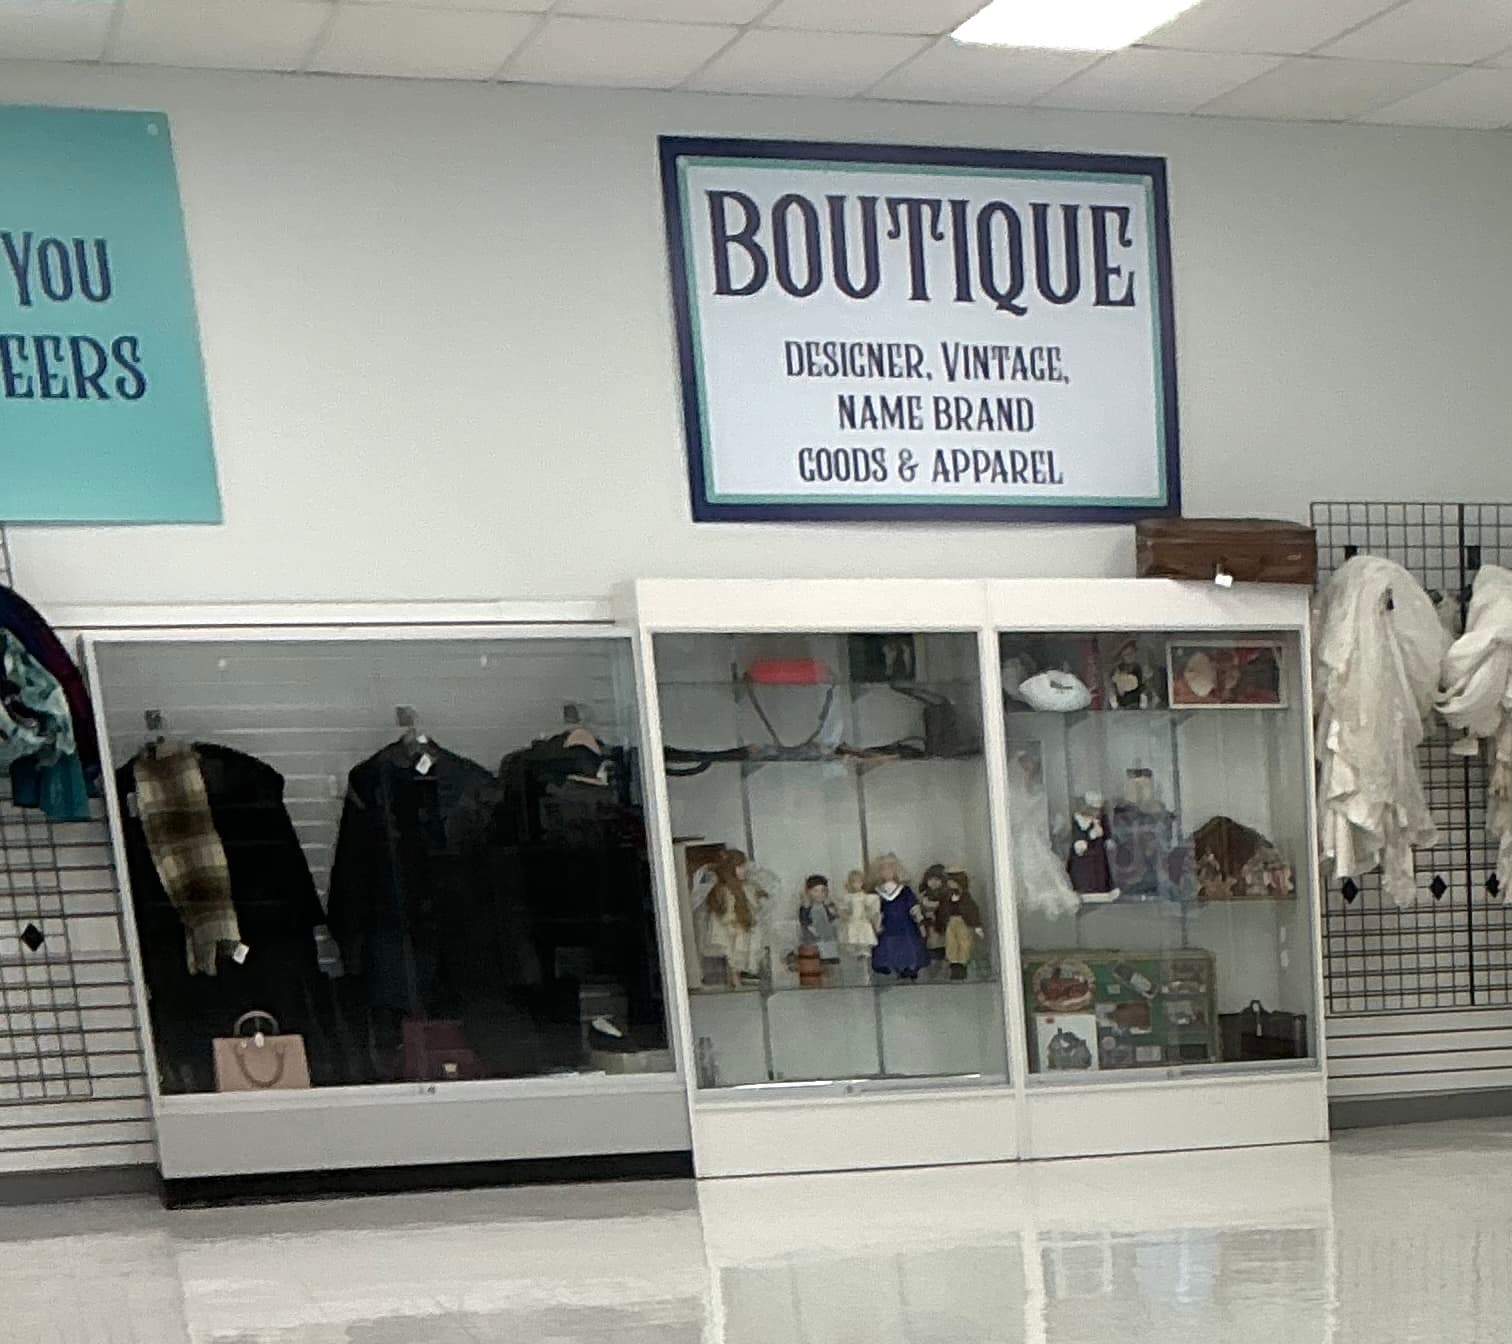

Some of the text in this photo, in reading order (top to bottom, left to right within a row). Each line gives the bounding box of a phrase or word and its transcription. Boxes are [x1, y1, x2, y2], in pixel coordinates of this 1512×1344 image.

[0, 230, 112, 307] YOU
[704, 189, 1136, 316] BOUTIQUE
[0, 334, 147, 400] EERS
[784, 340, 1070, 384] DESIGNER, VINTAGE,
[837, 394, 1035, 432] NAME BRAND
[798, 446, 1064, 484] GOODS & APPAREL
